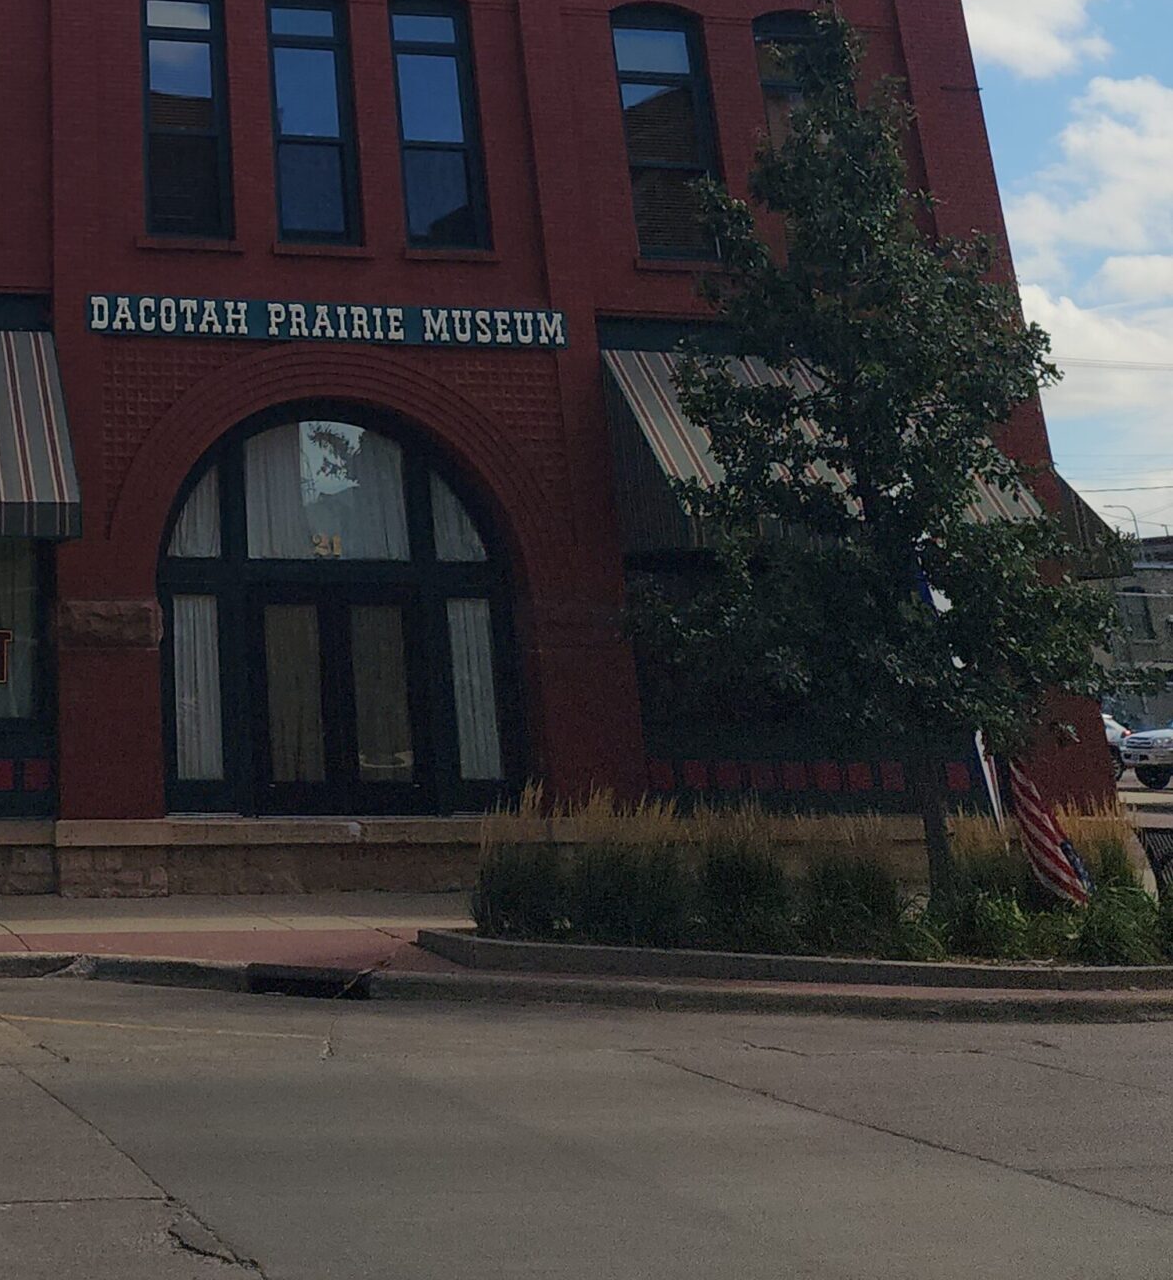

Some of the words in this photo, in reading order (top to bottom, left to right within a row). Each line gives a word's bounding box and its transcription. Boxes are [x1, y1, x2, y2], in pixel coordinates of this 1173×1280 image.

[89, 295, 249, 336] DACOTAH
[266, 302, 406, 341] PRAIRIE
[421, 308, 566, 345] MUSEUM
[312, 532, 342, 557] 21
